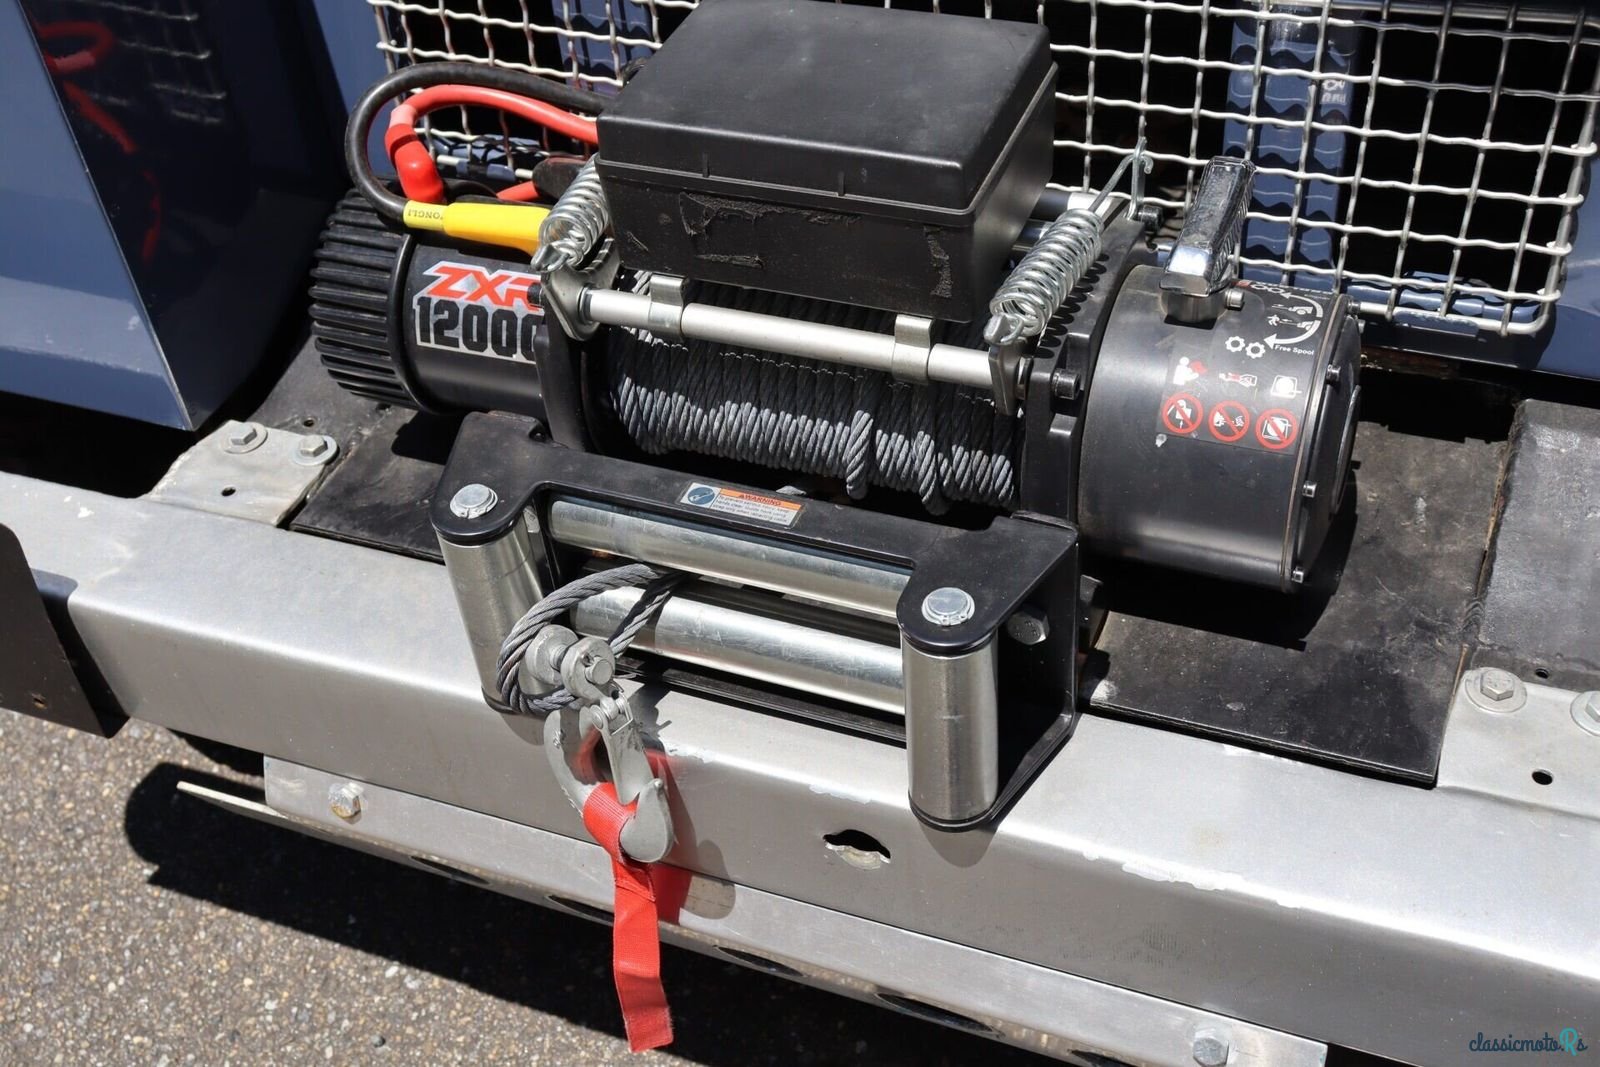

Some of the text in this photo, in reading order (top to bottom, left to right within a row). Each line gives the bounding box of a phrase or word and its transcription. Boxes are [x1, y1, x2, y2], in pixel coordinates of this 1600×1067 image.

[407, 209, 443, 220] ONGLI
[1274, 344, 1315, 355] Free Spool
[744, 494, 782, 506] WARNING
